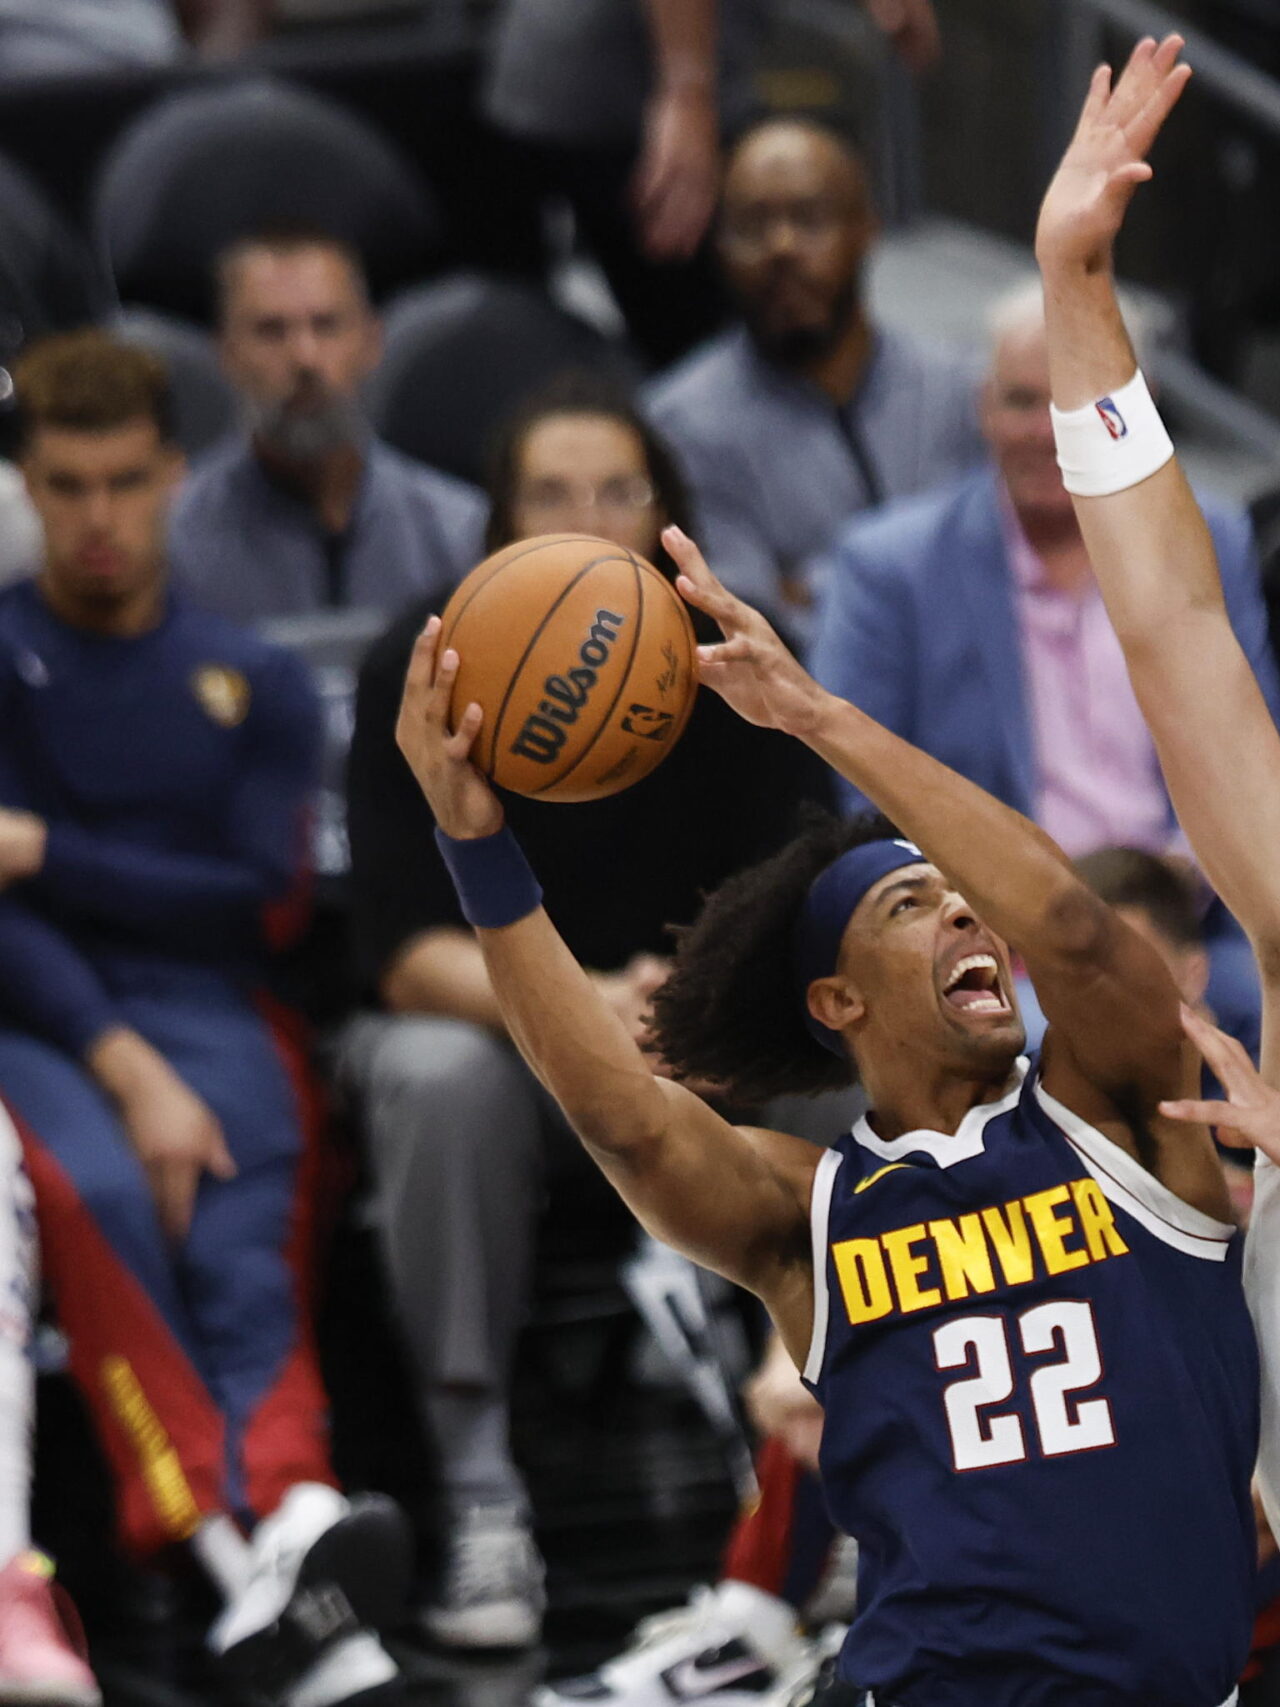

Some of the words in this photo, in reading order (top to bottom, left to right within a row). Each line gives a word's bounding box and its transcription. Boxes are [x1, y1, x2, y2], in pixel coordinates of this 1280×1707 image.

[510, 608, 625, 765] Wilson
[831, 1177, 1130, 1326] DENVER
[932, 1298, 1118, 1473] 22
